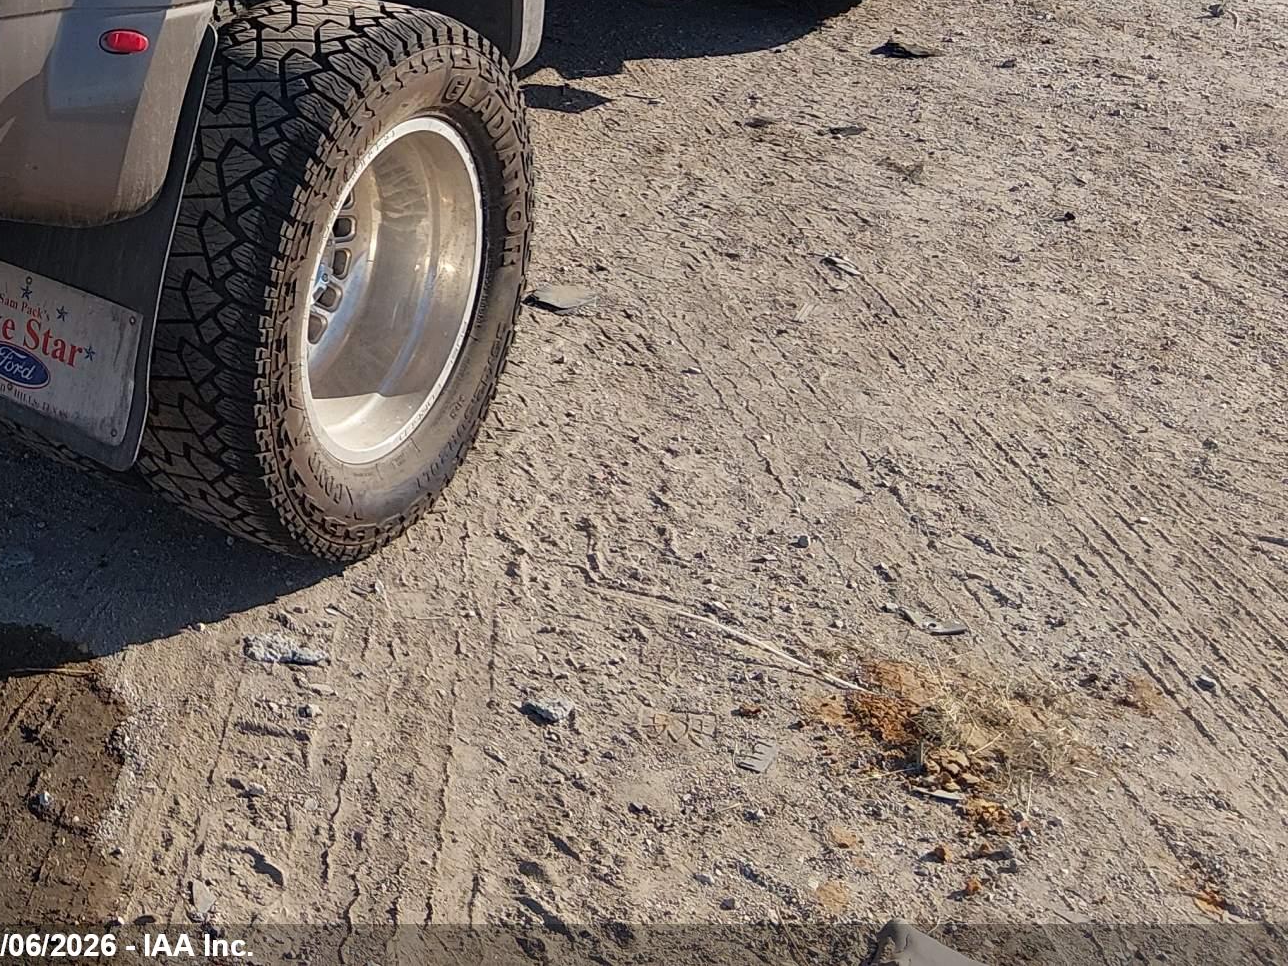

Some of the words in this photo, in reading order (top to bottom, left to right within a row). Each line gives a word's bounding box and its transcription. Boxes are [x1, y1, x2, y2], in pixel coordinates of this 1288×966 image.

[441, 74, 524, 268] GLADIATOR
[20, 298, 51, 322] Pack's
[22, 316, 85, 368] Star
